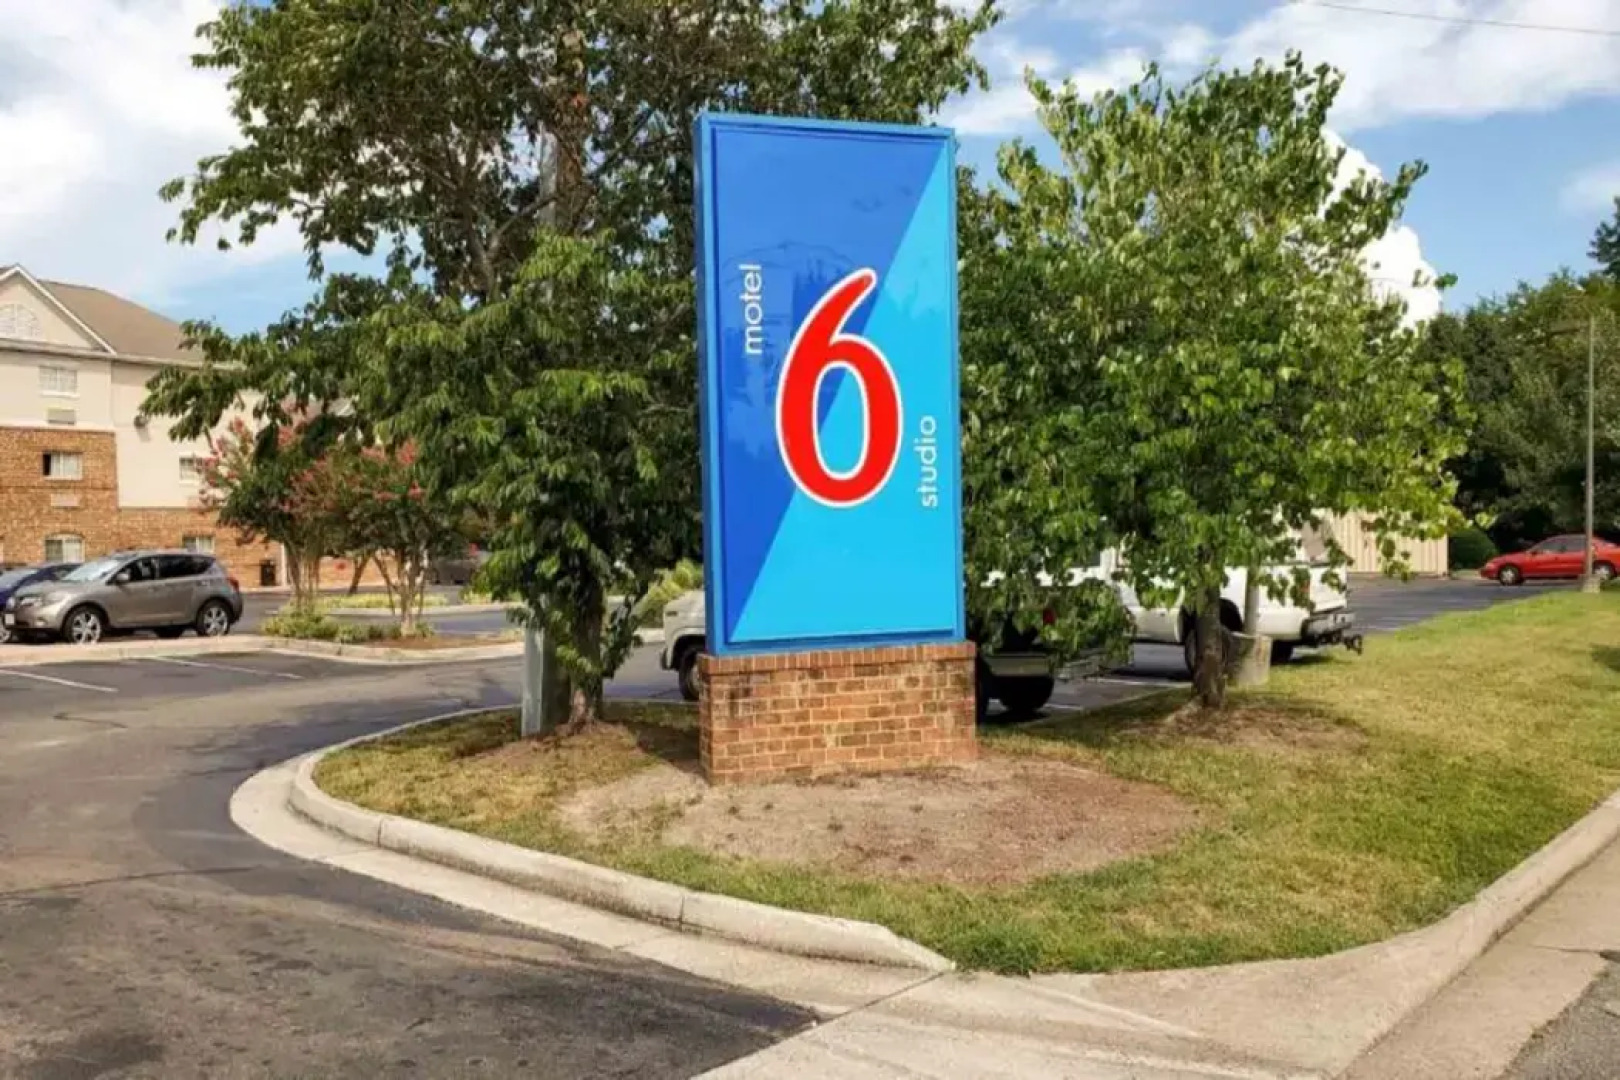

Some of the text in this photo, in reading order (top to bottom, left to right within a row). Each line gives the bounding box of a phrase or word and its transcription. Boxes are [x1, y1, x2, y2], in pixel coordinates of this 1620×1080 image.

[738, 264, 763, 355] motel
[775, 267, 903, 508] 6
[913, 414, 938, 508] studio
